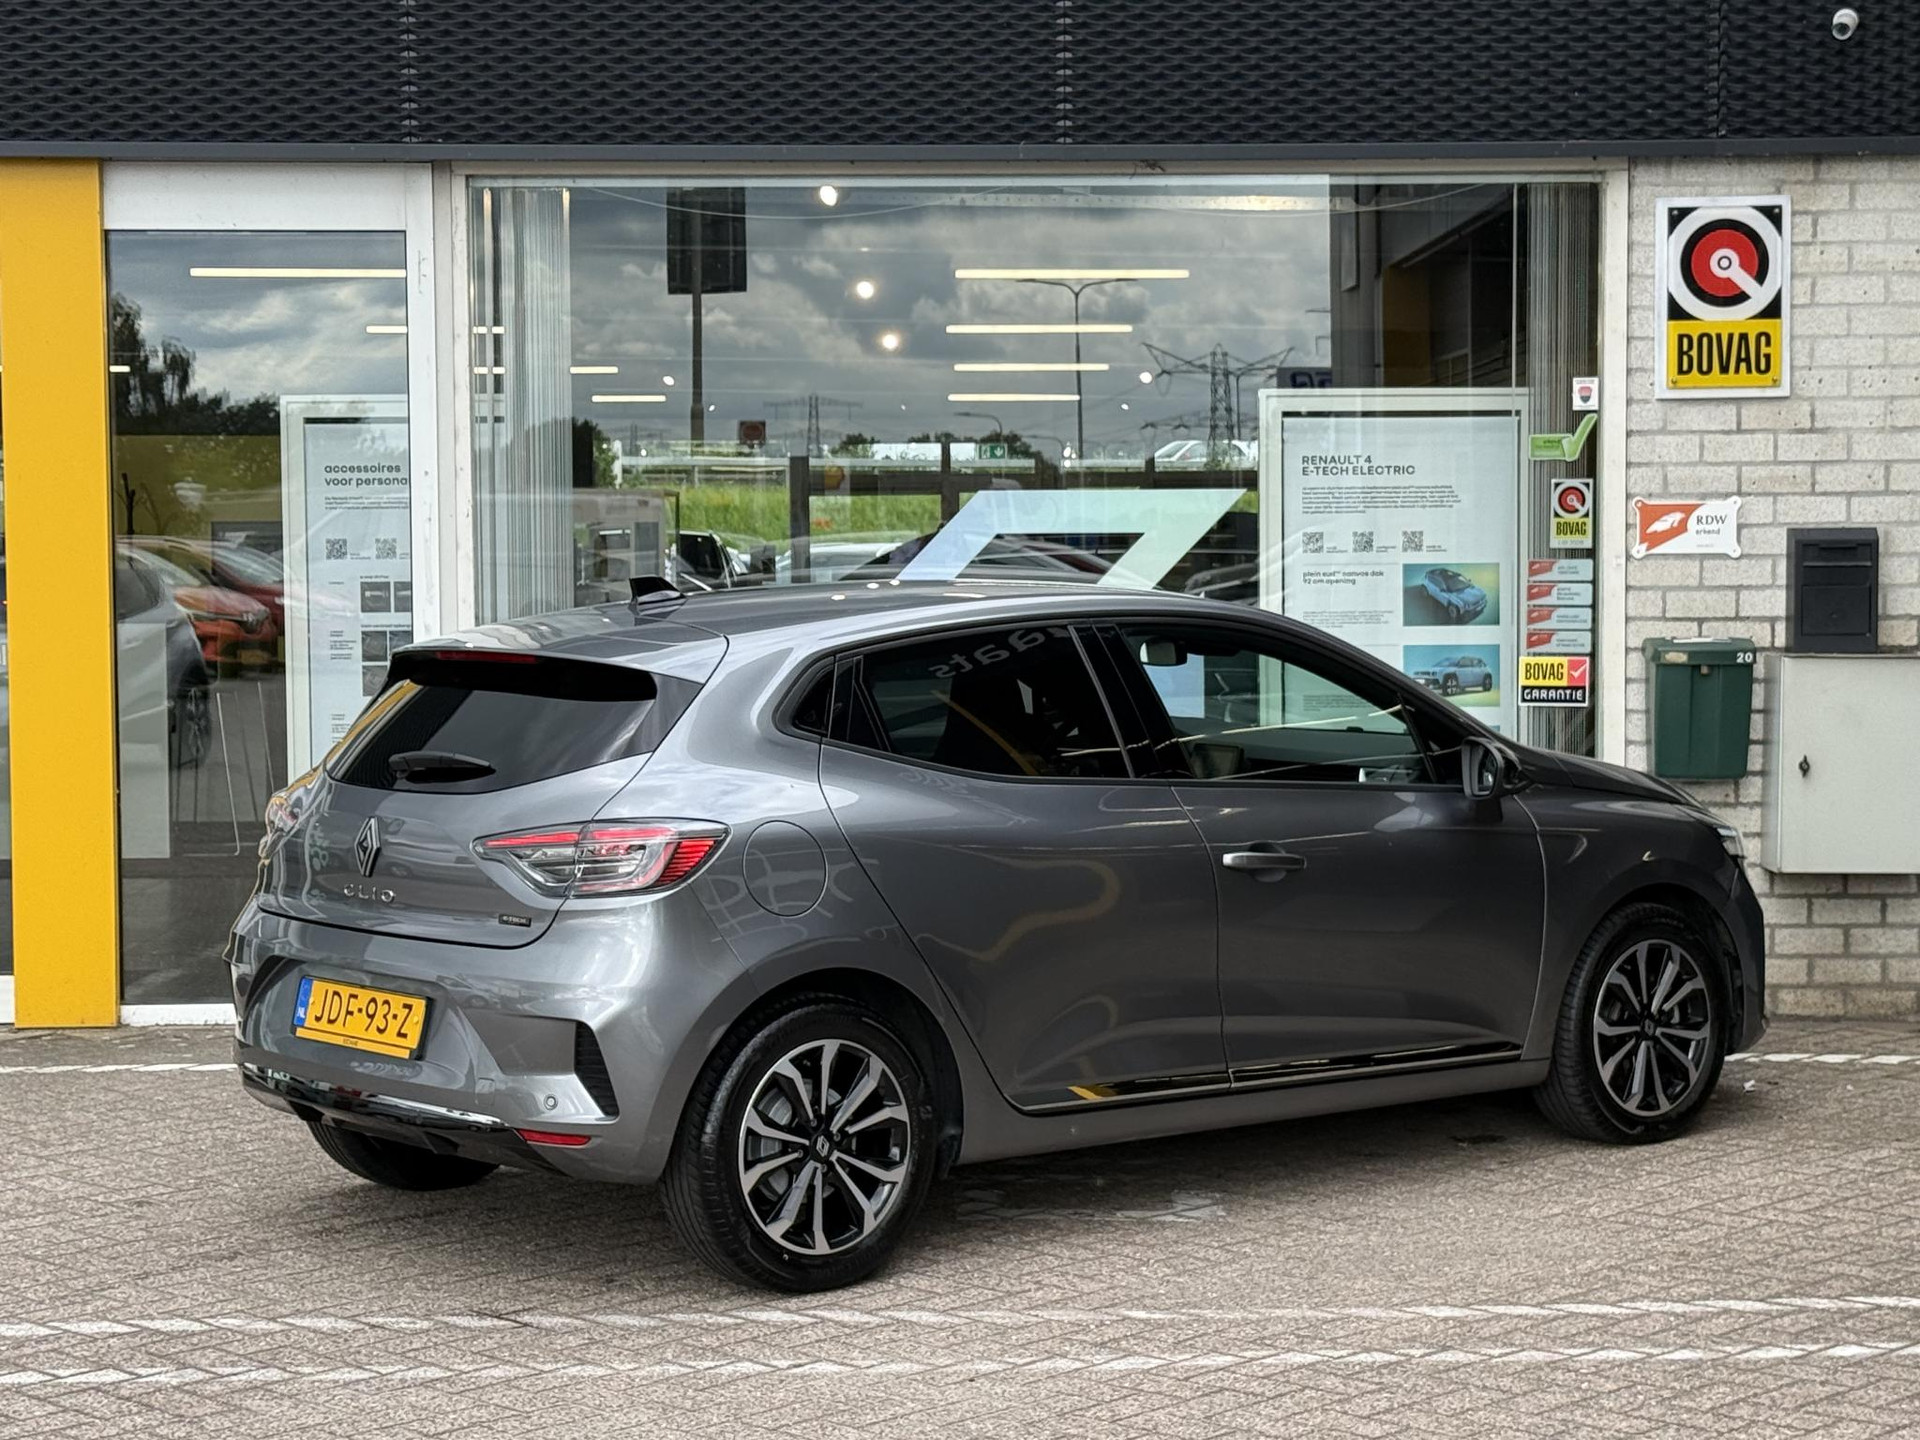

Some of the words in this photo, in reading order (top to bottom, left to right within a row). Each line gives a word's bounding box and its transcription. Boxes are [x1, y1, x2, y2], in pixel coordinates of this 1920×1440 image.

[1677, 331, 1772, 376] BOVAG
[1302, 455, 1362, 465] RENAULT
[1364, 454, 1372, 465] 4
[324, 462, 401, 474] accessoires
[1302, 466, 1349, 476] E-TECH
[1352, 465, 1415, 475] ELECTRIC
[325, 477, 353, 486] voor
[1696, 514, 1727, 525] RDW
[1555, 521, 1587, 536] BOVAG
[1736, 652, 1753, 663] 20
[1524, 662, 1564, 681] BOVAG
[1523, 688, 1583, 701] GARANTIE
[343, 884, 396, 903] CLIO
[314, 988, 413, 1040] JDF-93-Z
